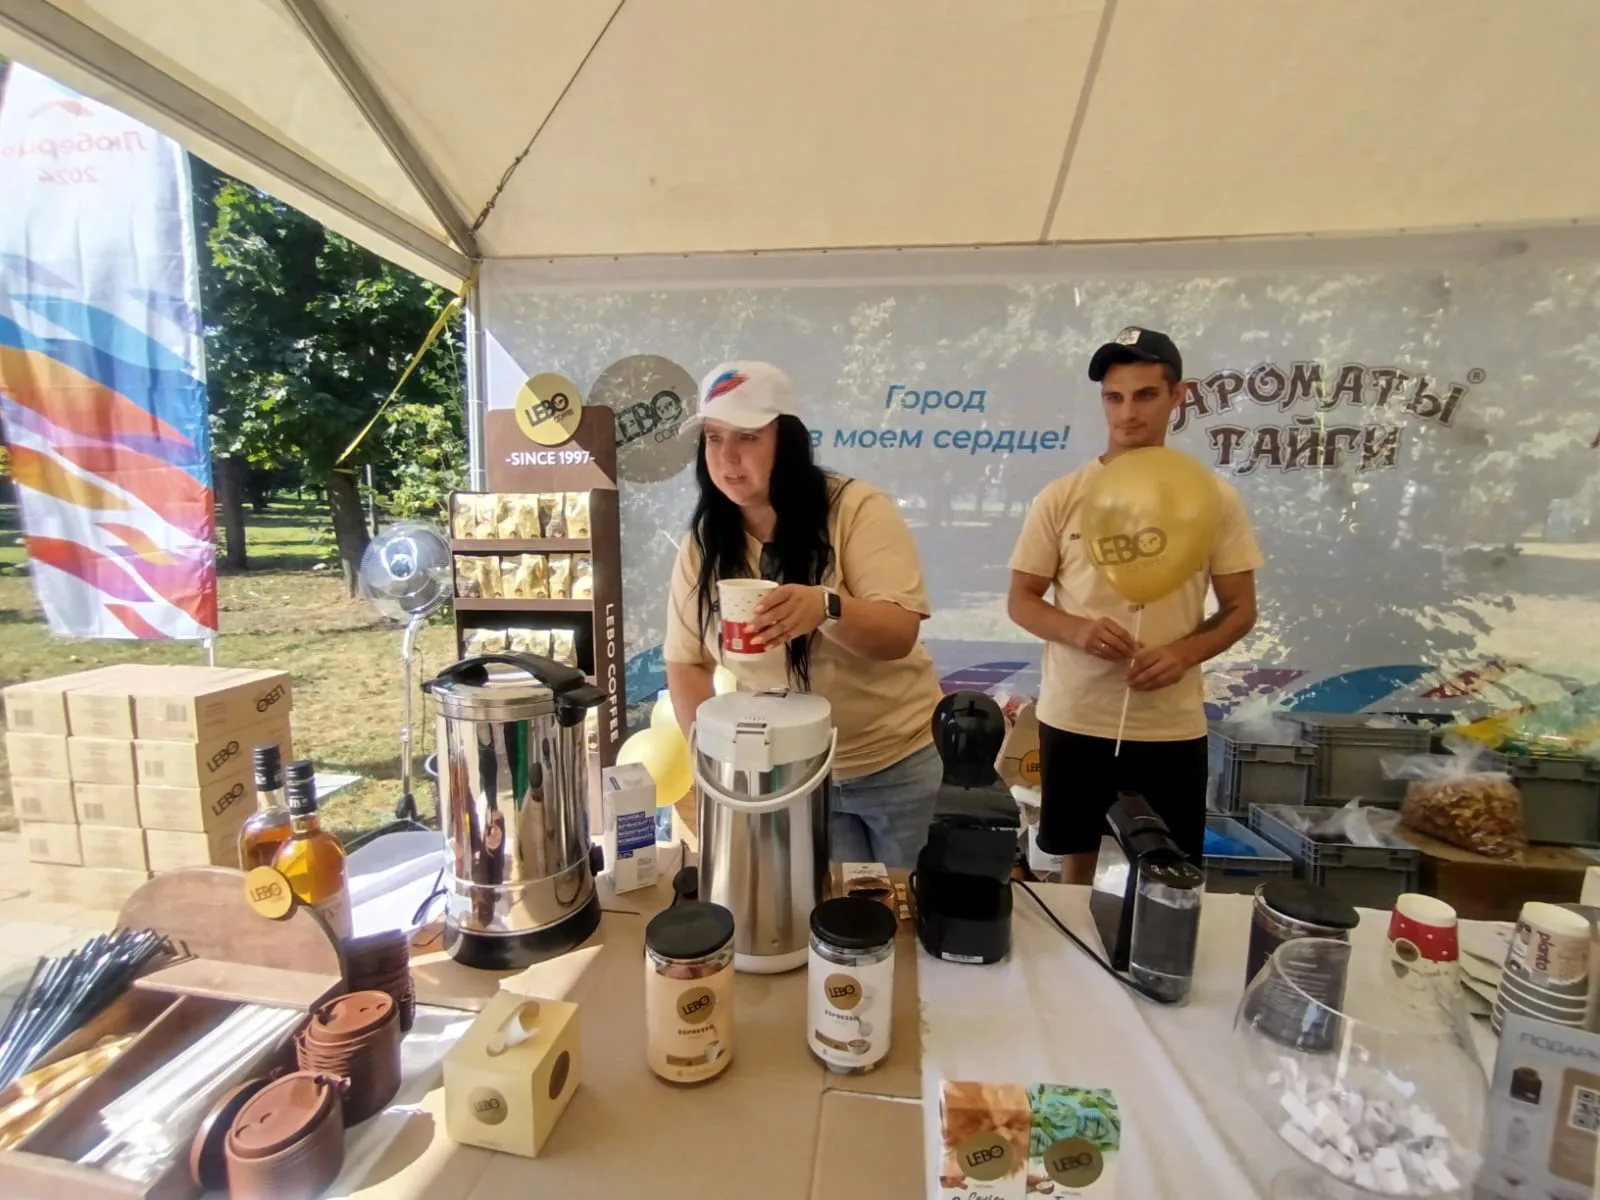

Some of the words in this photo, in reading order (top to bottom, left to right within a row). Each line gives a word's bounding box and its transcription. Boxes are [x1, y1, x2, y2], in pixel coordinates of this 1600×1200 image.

[524, 393, 569, 427] LEBO
[884, 384, 986, 415] Город
[1170, 361, 1467, 428] АРОМАТЫ
[615, 390, 683, 448] EBO
[810, 431, 823, 448] в
[833, 428, 924, 450] моем
[933, 424, 1071, 455] сердце!
[1205, 416, 1402, 476] ТАЙГИ
[1088, 526, 1168, 566] LEBO
[605, 603, 616, 659] LEBO
[256, 684, 286, 713] LEBO
[607, 663, 620, 743] COFFEE
[206, 740, 239, 773] LEBO
[1026, 762, 1041, 774] LEB
[211, 783, 244, 816] LEBO
[250, 882, 282, 903] LEBO
[682, 994, 710, 1016] LEBO
[829, 984, 856, 998] LEBO
[965, 1144, 1005, 1168] LEBO
[1052, 1151, 1093, 1173] LEBO
